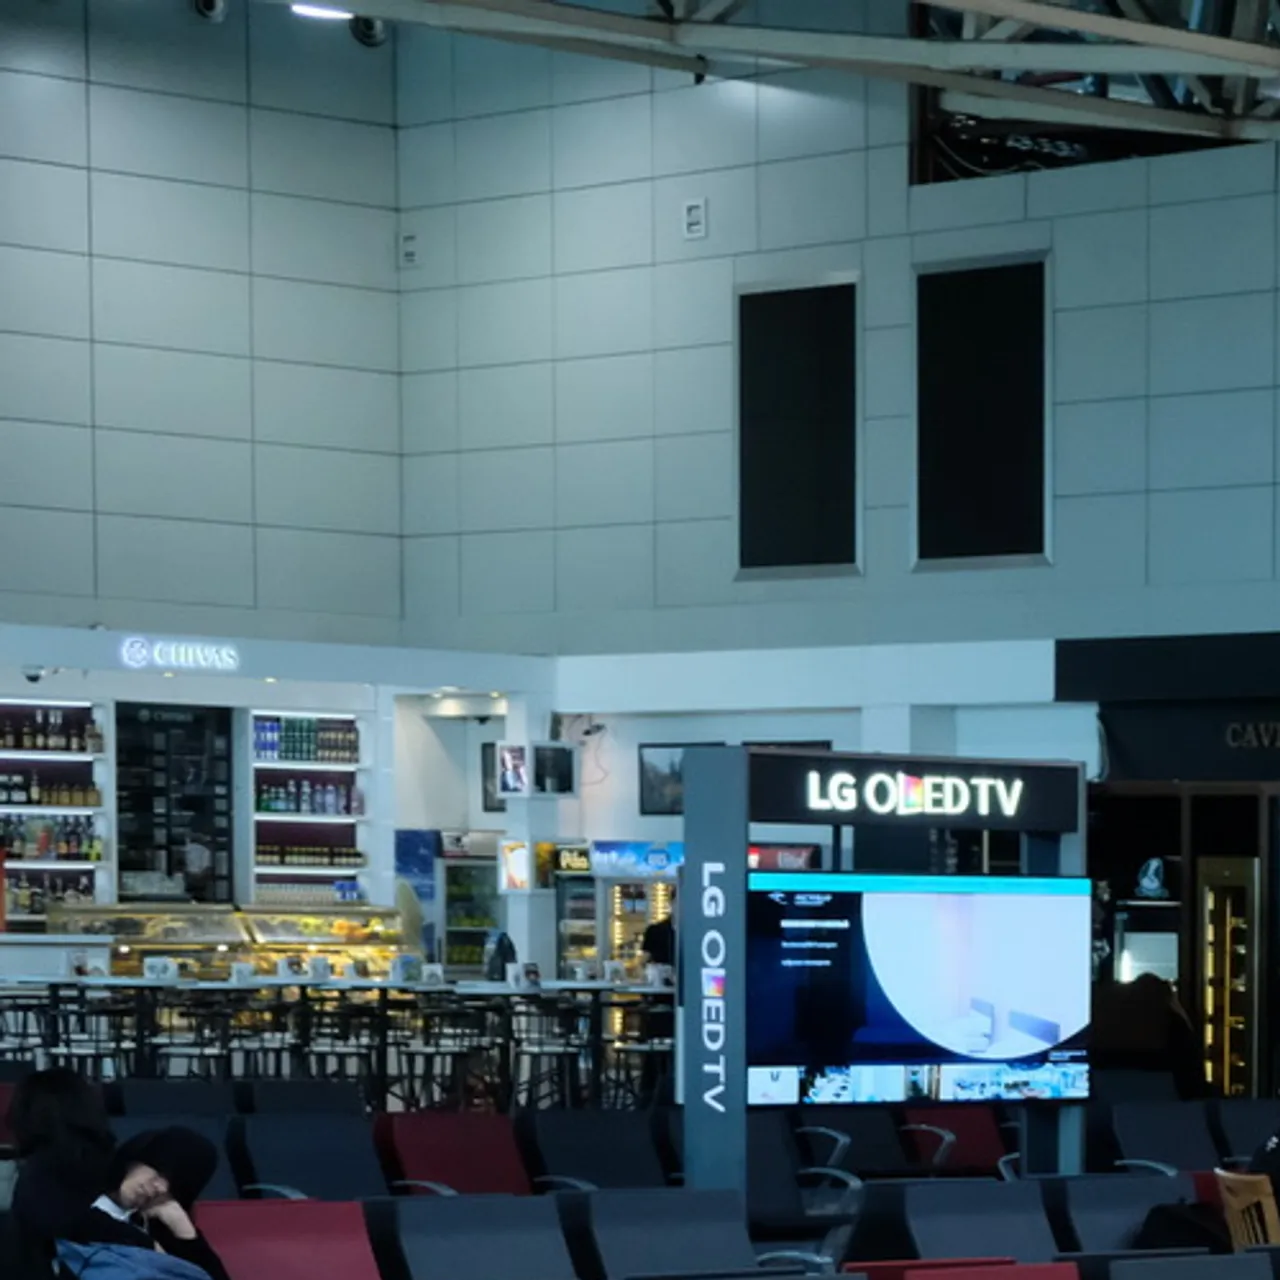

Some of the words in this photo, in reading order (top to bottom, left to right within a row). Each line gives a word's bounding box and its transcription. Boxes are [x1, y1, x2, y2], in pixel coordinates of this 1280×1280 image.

[153, 642, 239, 670] CHIVAS
[807, 770, 858, 811] LG
[863, 771, 972, 816] OLED
[972, 777, 1024, 817] TV
[702, 861, 726, 918] LG
[701, 929, 726, 1051] OLED
[702, 1055, 726, 1113] TV
